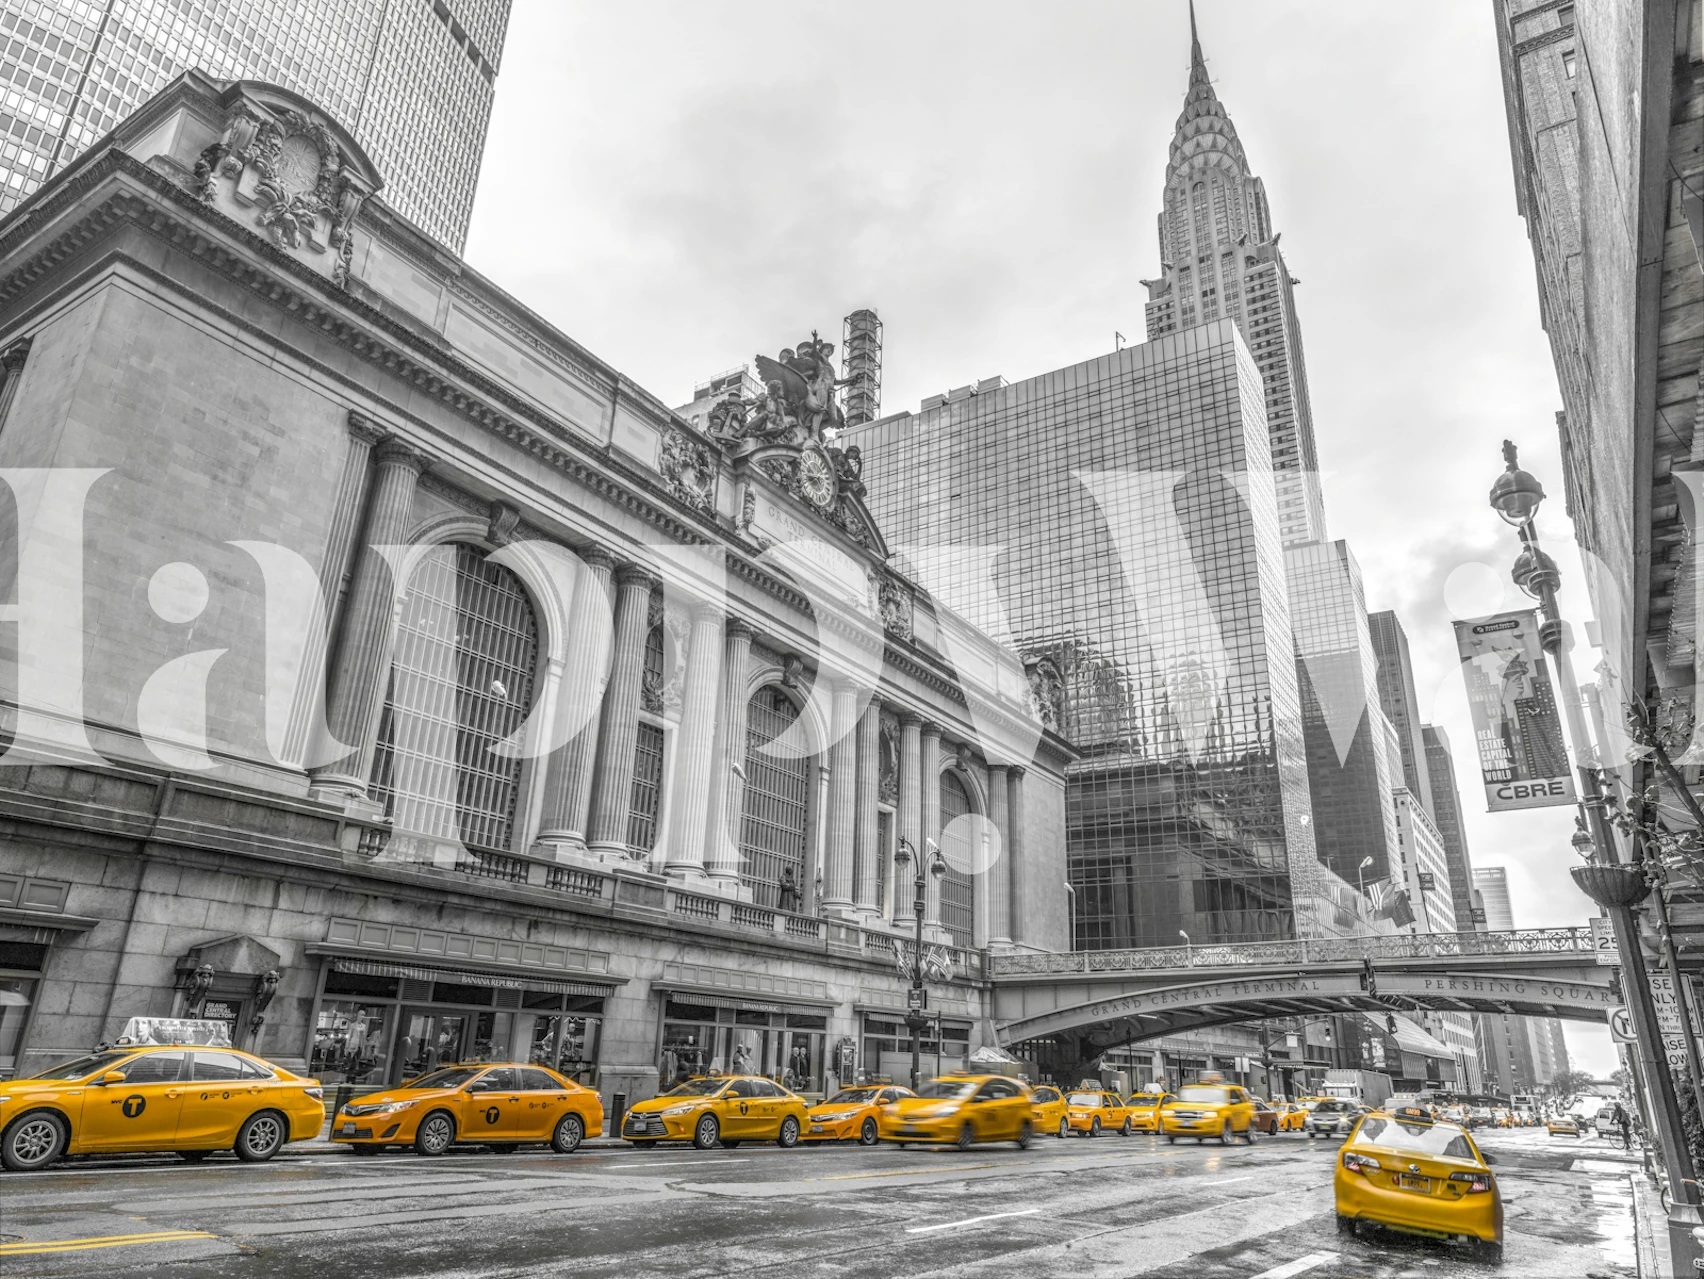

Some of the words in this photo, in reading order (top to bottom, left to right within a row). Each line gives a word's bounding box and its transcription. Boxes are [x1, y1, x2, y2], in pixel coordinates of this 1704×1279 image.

[768, 506, 805, 537] GRAND
[811, 535, 855, 572] CENTRAL
[788, 530, 837, 572] TERMINAL
[1477, 729, 1496, 740] REAL
[1479, 738, 1506, 750] ESTATE
[1481, 748, 1512, 760] CAPITAL
[1483, 761, 1492, 771] OF
[1494, 759, 1509, 769] THE
[1485, 769, 1511, 781] WORLD
[1497, 782, 1565, 800] CBRE
[1598, 937, 1618, 949] 25
[461, 975, 490, 985] BANANA
[491, 979, 523, 988] REPUBLIC
[1425, 979, 1525, 994] PERSHING
[1541, 985, 1610, 1002] SQUAR
[1091, 1000, 1142, 1016] GRAND
[1151, 987, 1222, 1005] CENTRAL
[1232, 982, 1319, 995] TERMINAL
[1652, 993, 1676, 1003] NLY
[128, 1098, 142, 1116] T
